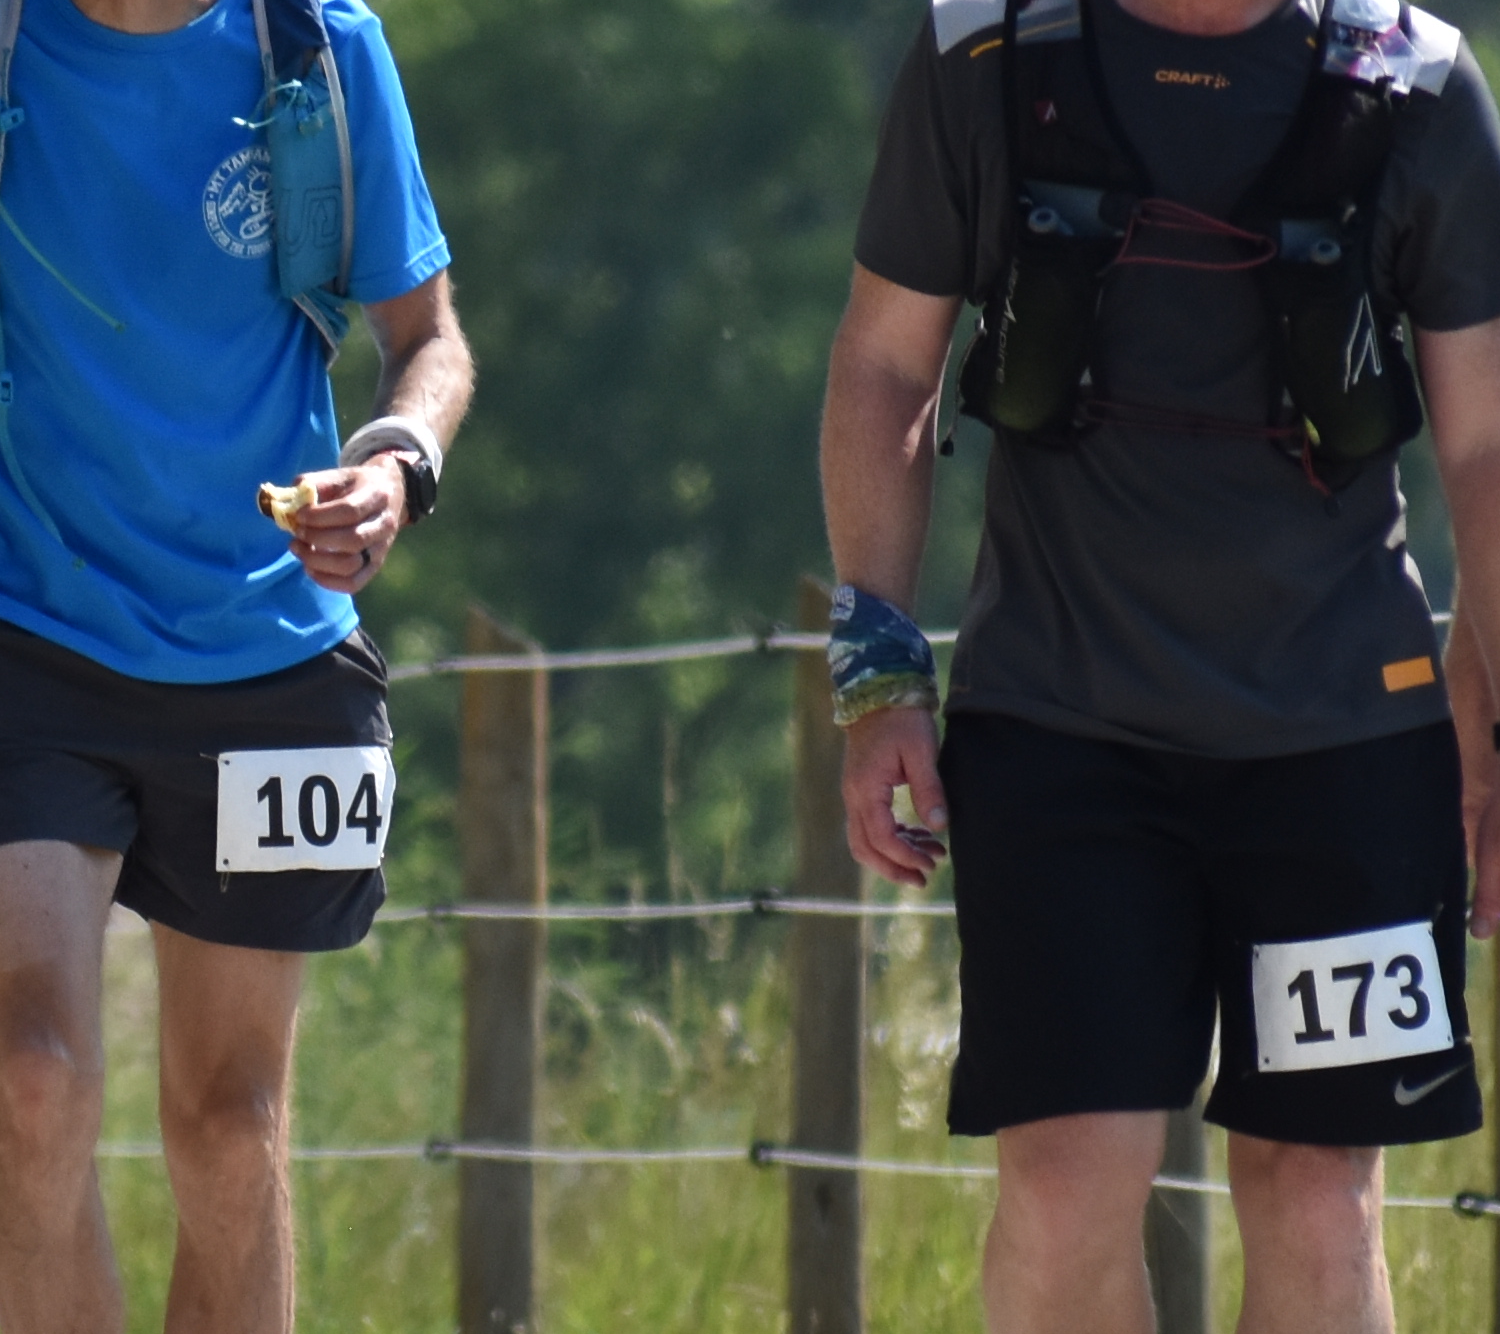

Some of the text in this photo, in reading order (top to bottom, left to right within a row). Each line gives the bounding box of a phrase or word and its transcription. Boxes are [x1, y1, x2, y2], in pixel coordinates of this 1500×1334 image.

[1155, 69, 1214, 86] CRAFT
[256, 773, 383, 848] 104
[1288, 954, 1431, 1045] 173
